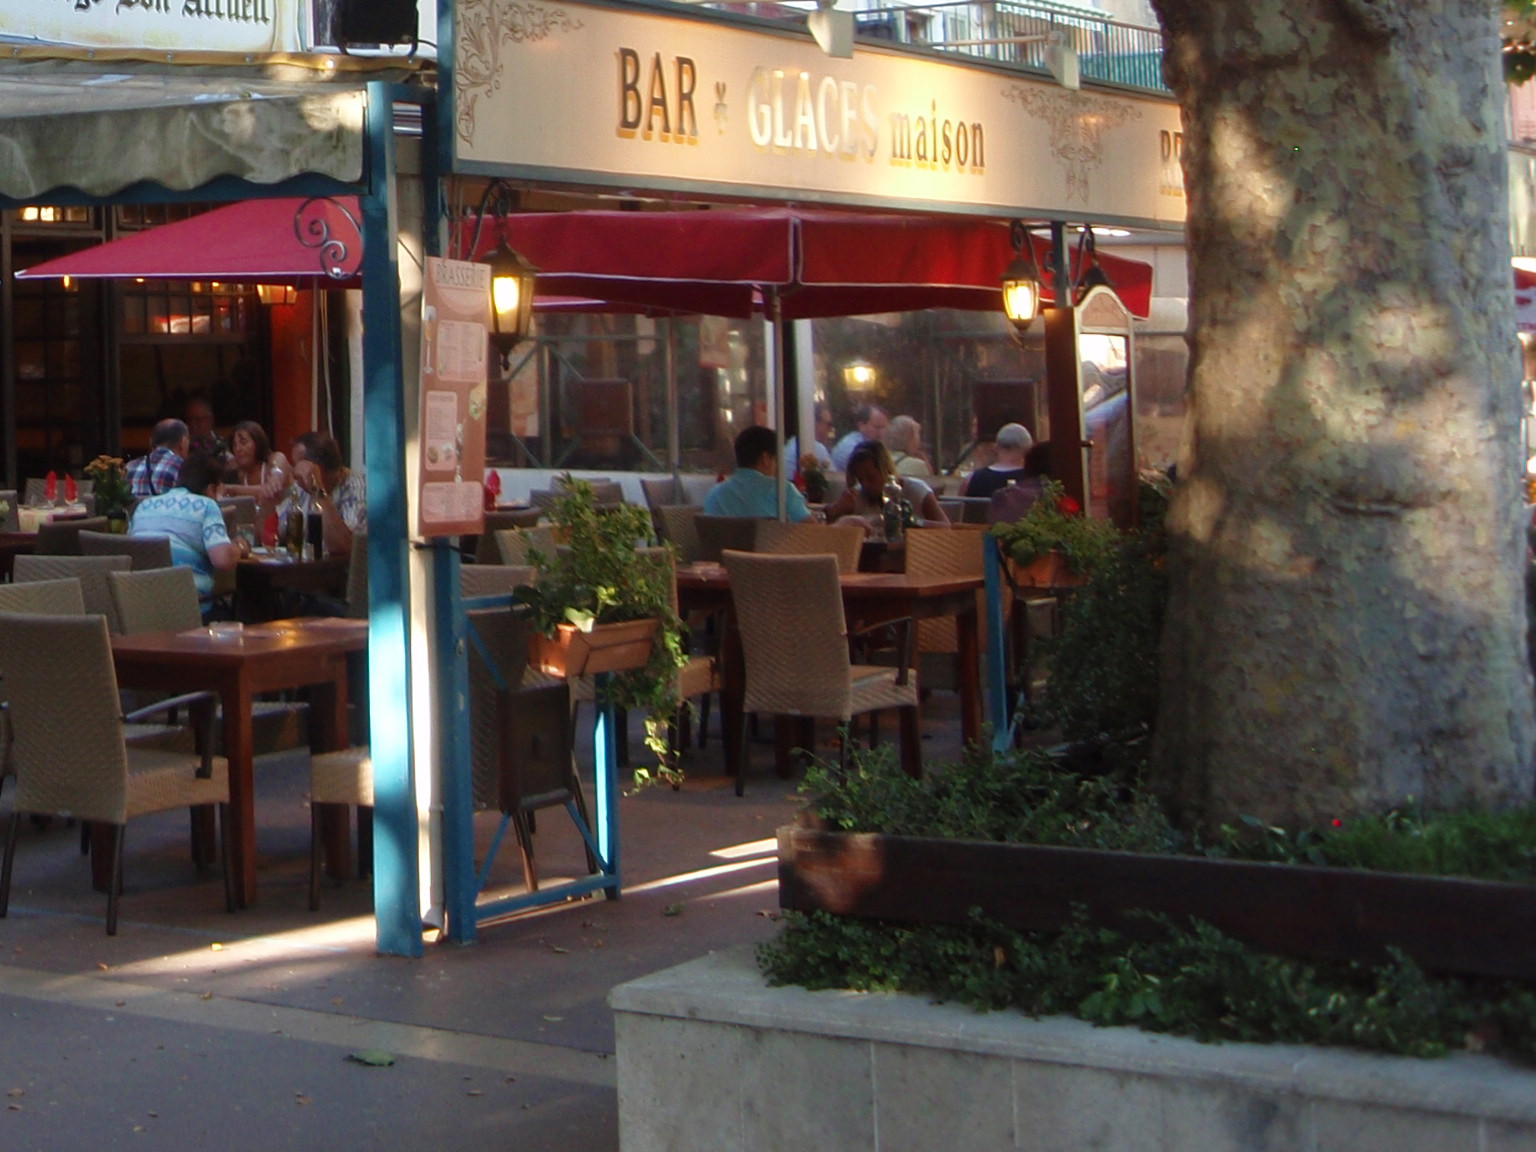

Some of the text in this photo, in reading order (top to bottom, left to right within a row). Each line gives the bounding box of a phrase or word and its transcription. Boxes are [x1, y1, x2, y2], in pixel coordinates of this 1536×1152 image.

[615, 46, 986, 172] BAR GLACES maison
[436, 262, 486, 290] BRASSERIE
